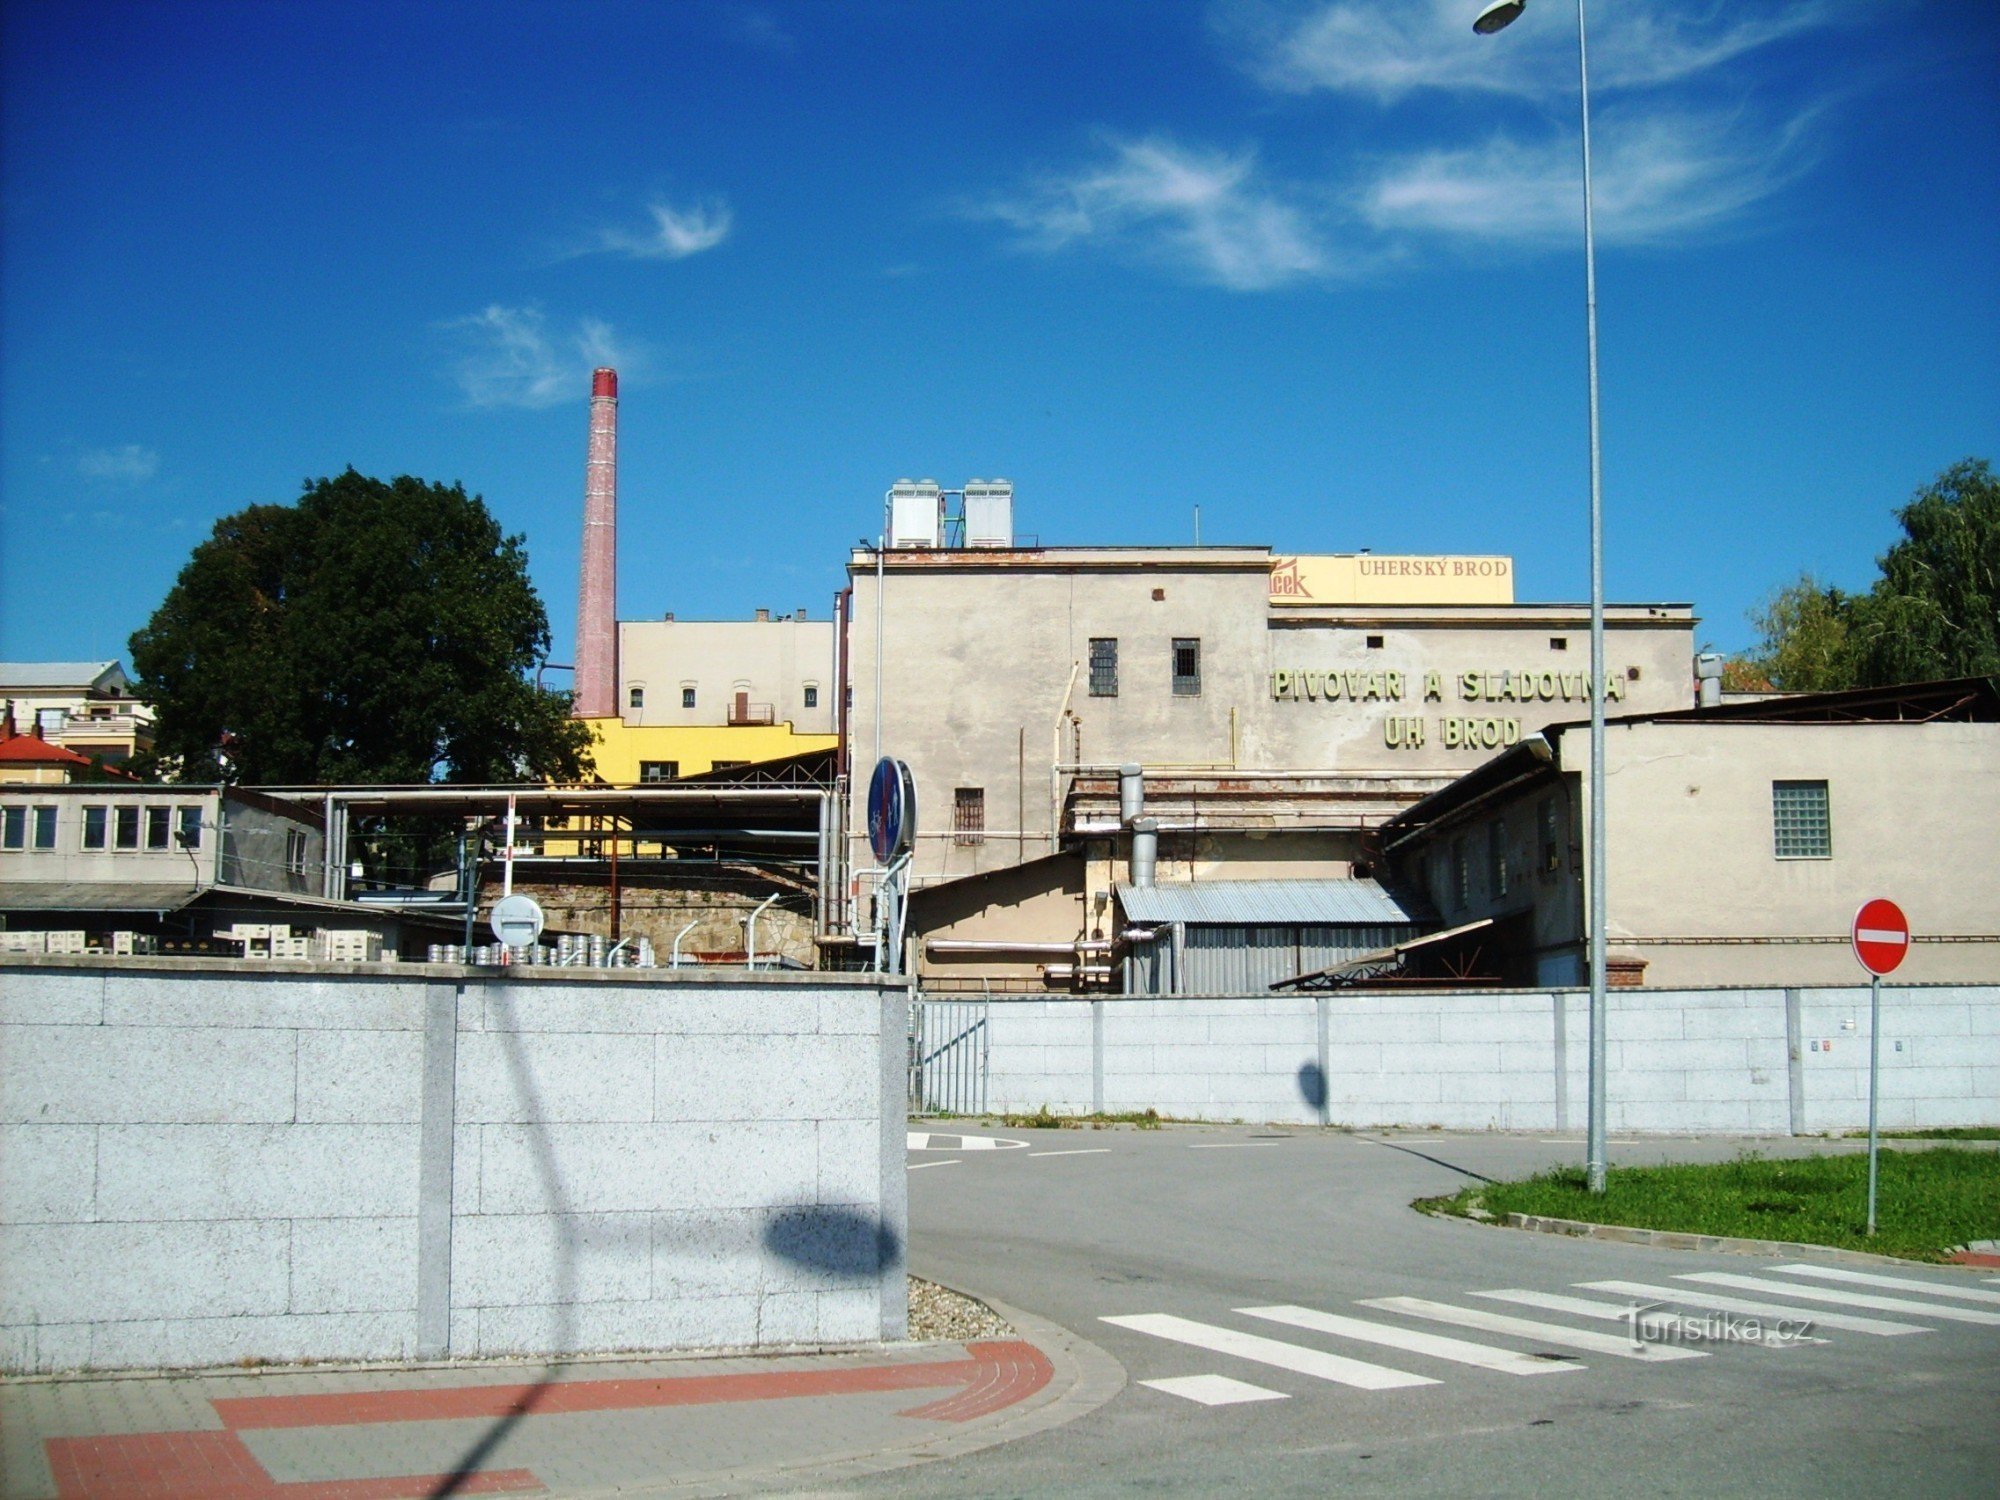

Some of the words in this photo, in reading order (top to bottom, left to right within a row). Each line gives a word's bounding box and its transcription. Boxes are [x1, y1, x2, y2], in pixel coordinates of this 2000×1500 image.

[1269, 560, 1314, 599] ček
[1359, 557, 1447, 576] UHERSKÝ
[1453, 560, 1508, 577] BROD
[1273, 668, 1401, 701] PIVOVAR
[1424, 668, 1442, 701] A
[1462, 669, 1621, 702] SLADOVNA
[1445, 717, 1520, 749] BROD
